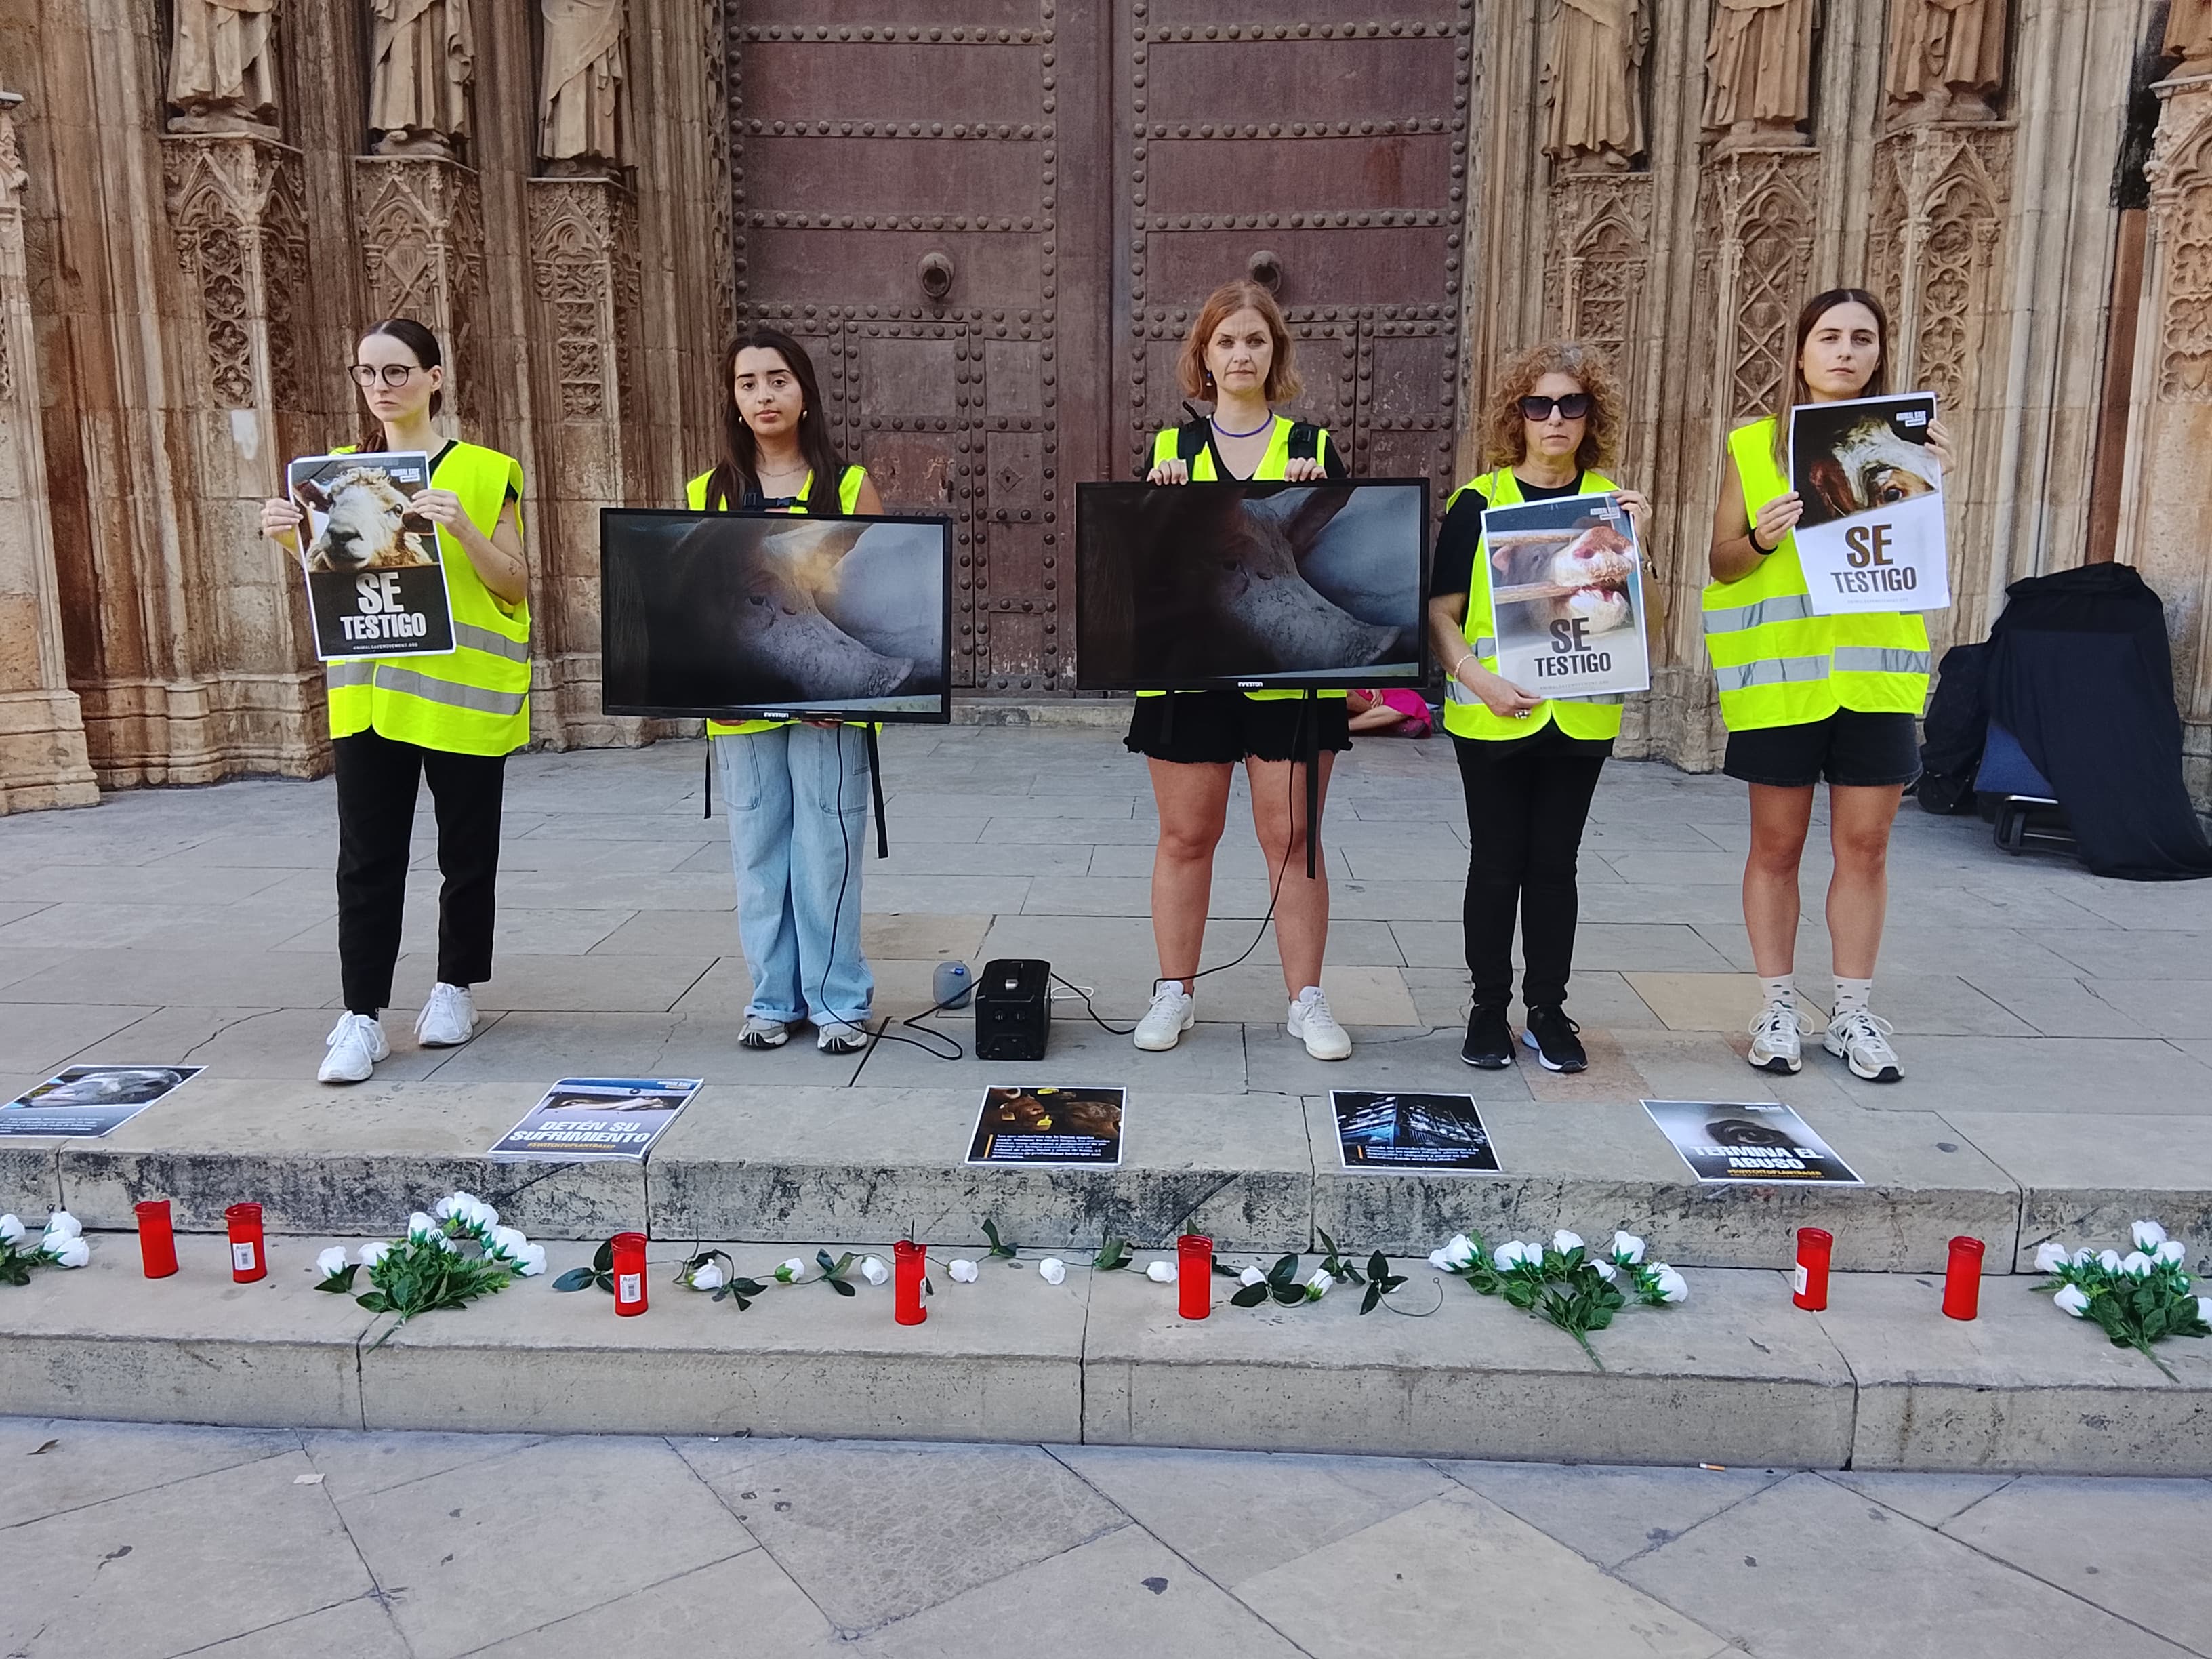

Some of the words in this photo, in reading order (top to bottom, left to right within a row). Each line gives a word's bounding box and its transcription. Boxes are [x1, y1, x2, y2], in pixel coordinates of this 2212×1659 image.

[1845, 524, 1893, 568] SE
[356, 572, 404, 614] SE
[1830, 567, 1917, 594] TESTIGO
[340, 613, 426, 640] TESTIGO
[1549, 617, 1591, 653] SE
[1534, 653, 1611, 677] TESTIGO
[509, 1131, 651, 1143] SUFRIMIENTO
[538, 1120, 607, 1131] DETÉN
[609, 1122, 641, 1132] SU
[1689, 1145, 1793, 1158] TERMINA
[1793, 1147, 1825, 1158] EL
[1728, 1157, 1807, 1169] ABUSO
